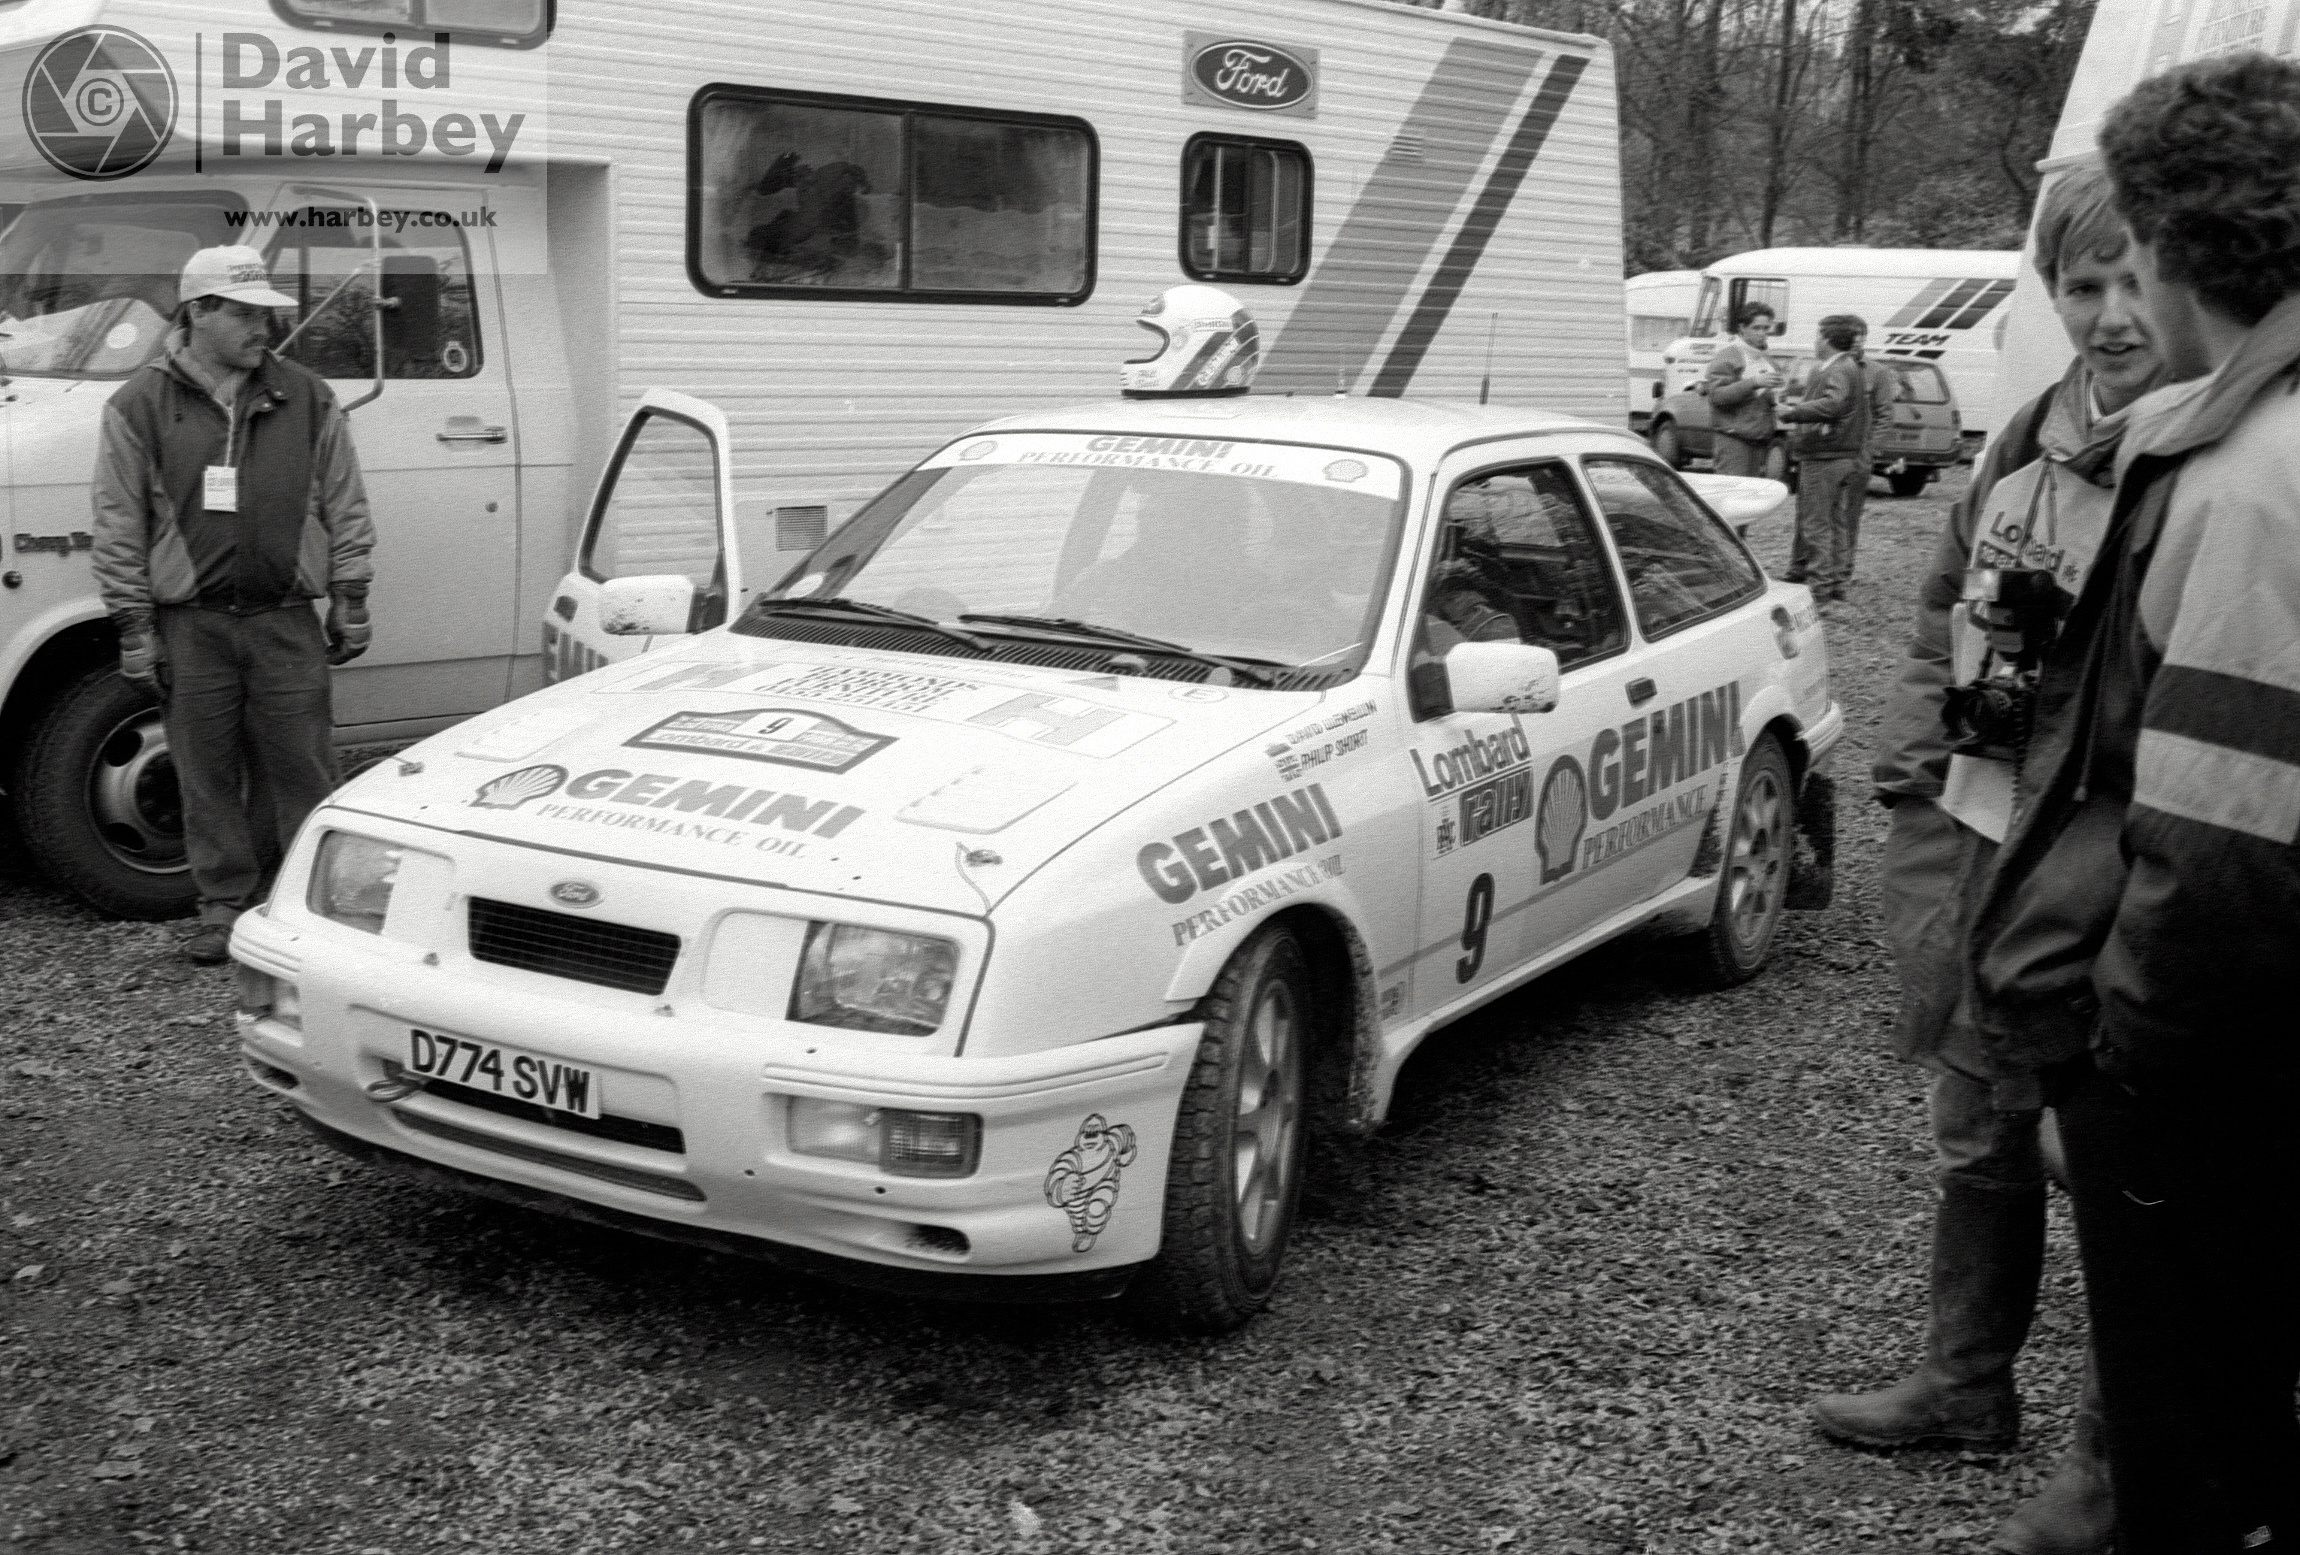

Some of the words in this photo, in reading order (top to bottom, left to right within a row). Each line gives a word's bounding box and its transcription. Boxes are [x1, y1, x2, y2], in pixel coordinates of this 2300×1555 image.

[1216, 48, 1290, 97] Ford
[1883, 332, 1952, 346] TEAM
[1017, 451, 1221, 472] PERFORMANCE
[1230, 462, 1278, 478] OIL
[1086, 435, 1236, 459] GEMINI
[758, 716, 795, 735] 9
[1301, 743, 1334, 770] PHILIP
[1335, 728, 1369, 757] SHORT
[1409, 713, 1532, 797] Lombard
[1588, 680, 1747, 821] GEMINI
[536, 802, 751, 847] PERFORMANCE
[754, 836, 808, 860] OIL
[565, 768, 867, 839] GEMINI
[1136, 782, 1344, 904] GEMINI
[1171, 864, 1324, 947] PERFORMANCE
[1456, 872, 1496, 985] 9
[410, 1028, 505, 1092] D774
[512, 1055, 590, 1113] SVW
